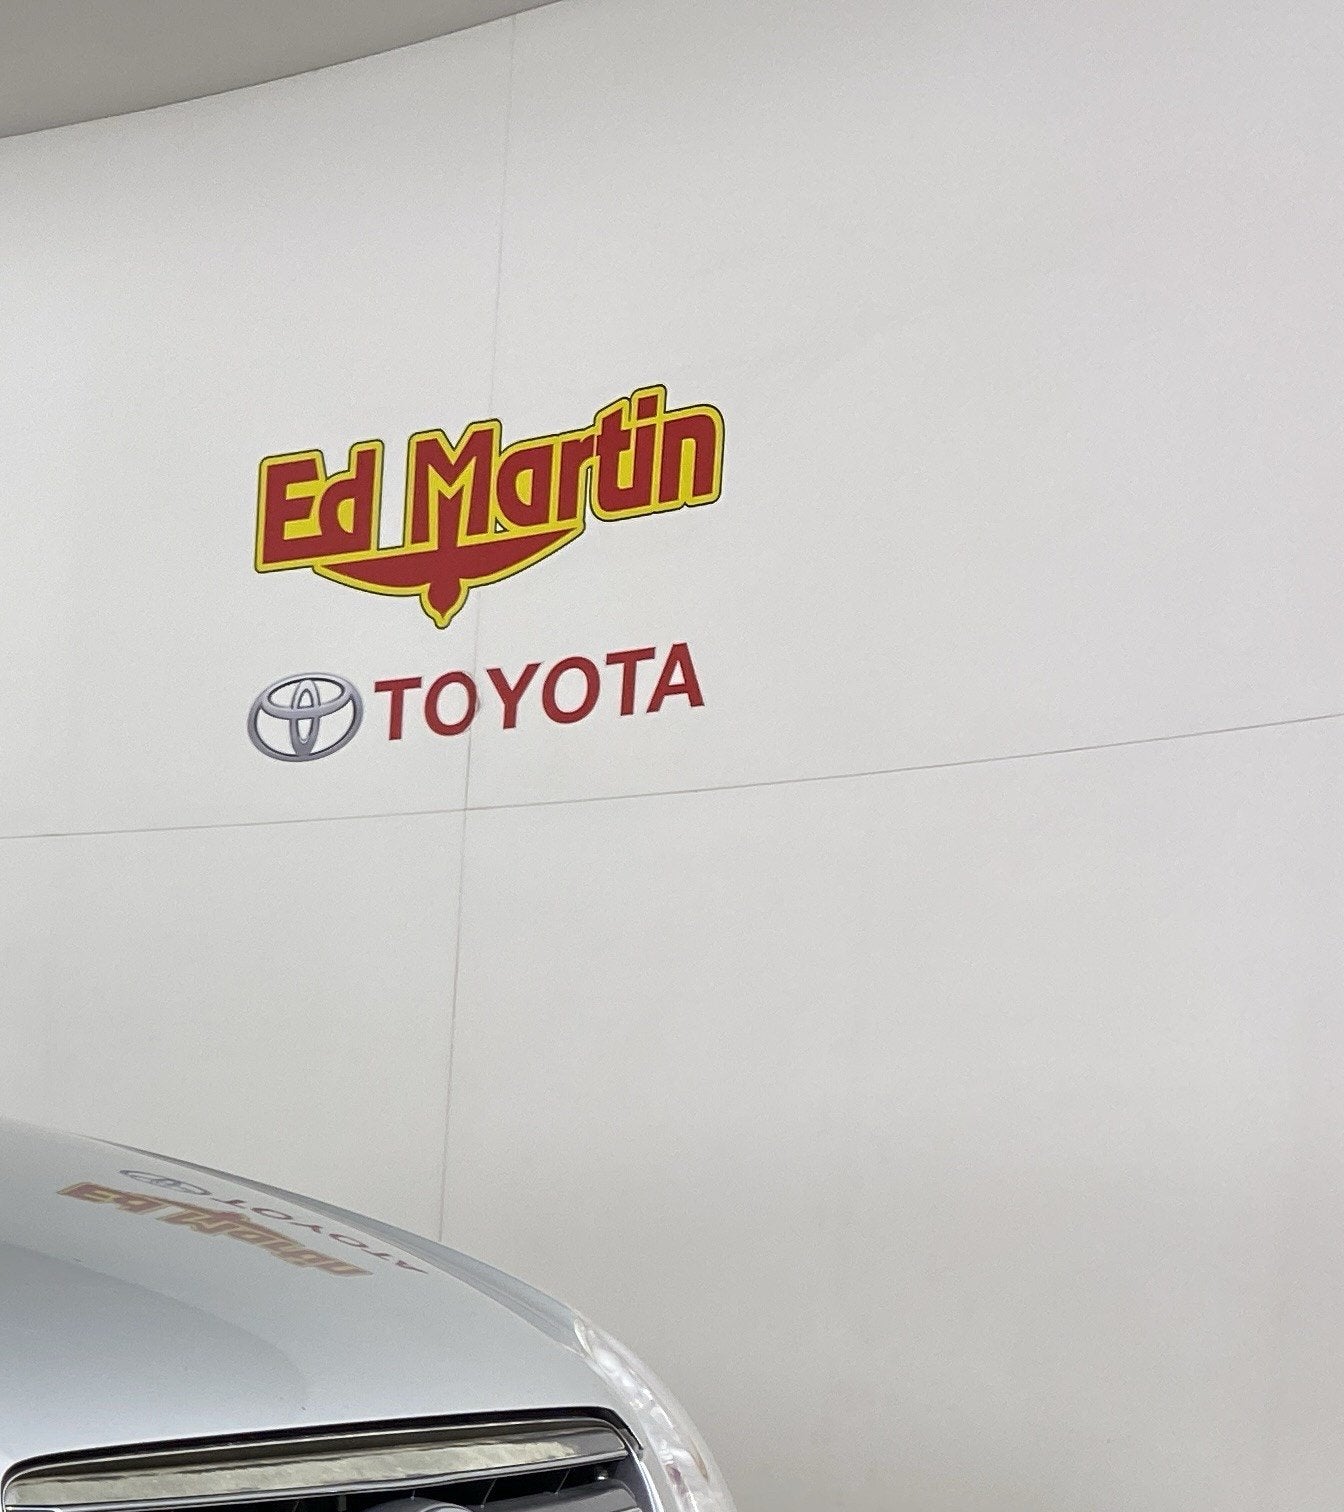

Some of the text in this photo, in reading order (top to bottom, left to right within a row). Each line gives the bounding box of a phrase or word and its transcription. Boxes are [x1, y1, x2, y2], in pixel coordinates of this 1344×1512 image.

[259, 391, 719, 567] Ed Martin
[374, 642, 704, 740] TOYOTA
